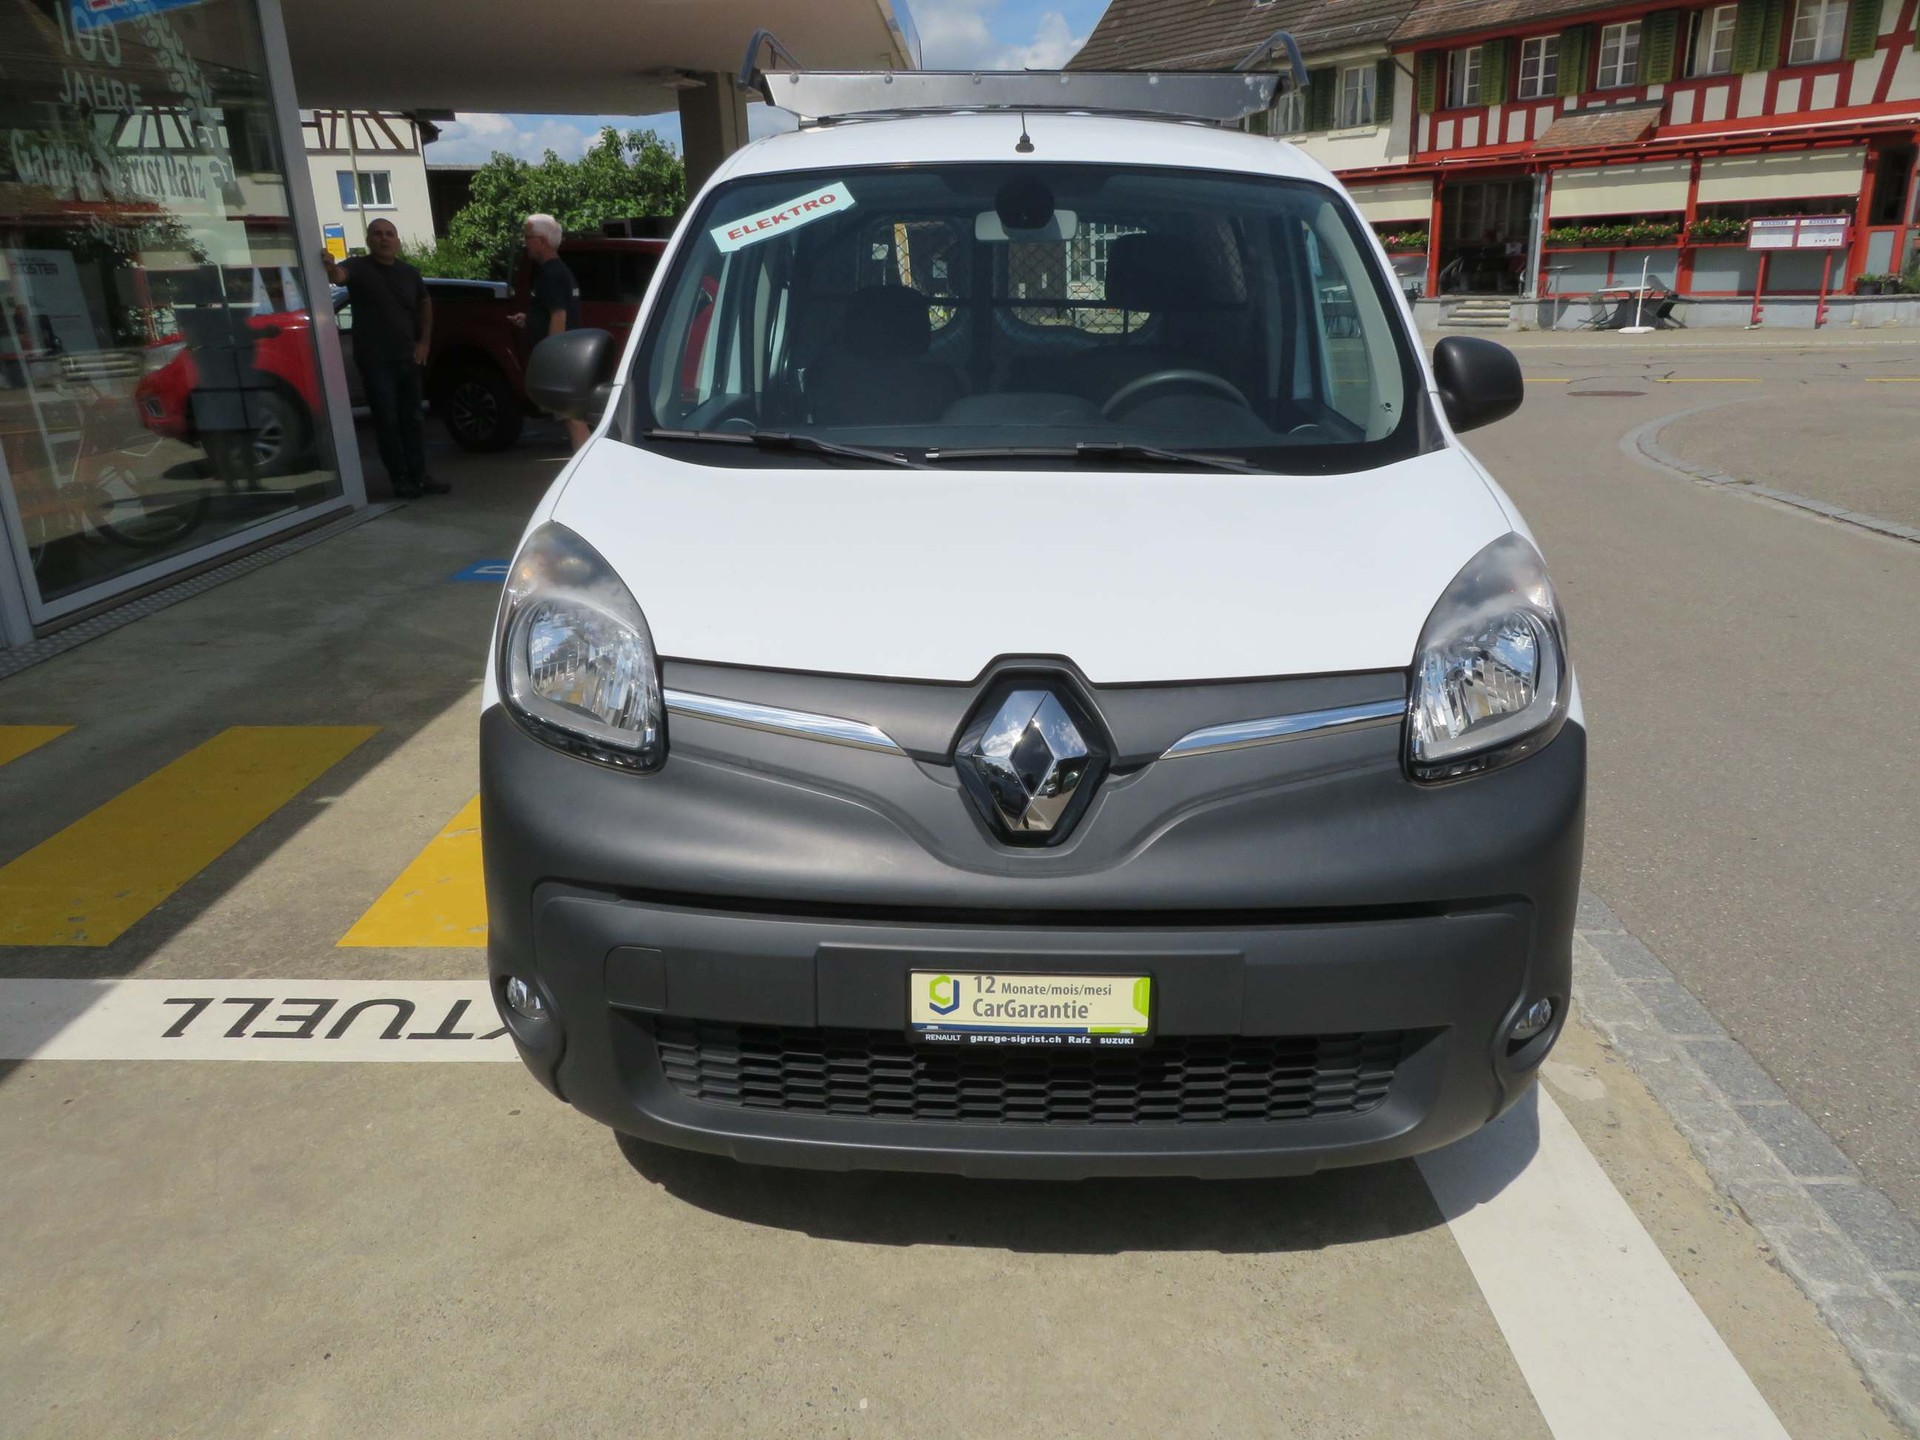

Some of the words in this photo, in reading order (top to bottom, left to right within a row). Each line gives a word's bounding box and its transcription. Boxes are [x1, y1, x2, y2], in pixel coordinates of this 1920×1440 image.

[55, 1, 121, 67] 100
[59, 68, 143, 114] JAHRE
[727, 194, 836, 240] ELEKTRO
[973, 975, 996, 994] 12
[1001, 983, 1112, 996] Monate/mois/mesi
[972, 998, 1089, 1019] CarGarantie
[925, 1033, 962, 1042] RENAULT
[970, 1035, 1062, 1045] garage-sigrist.ch
[1068, 1036, 1092, 1045] Rafz
[1100, 1037, 1135, 1046] SUZUKI
